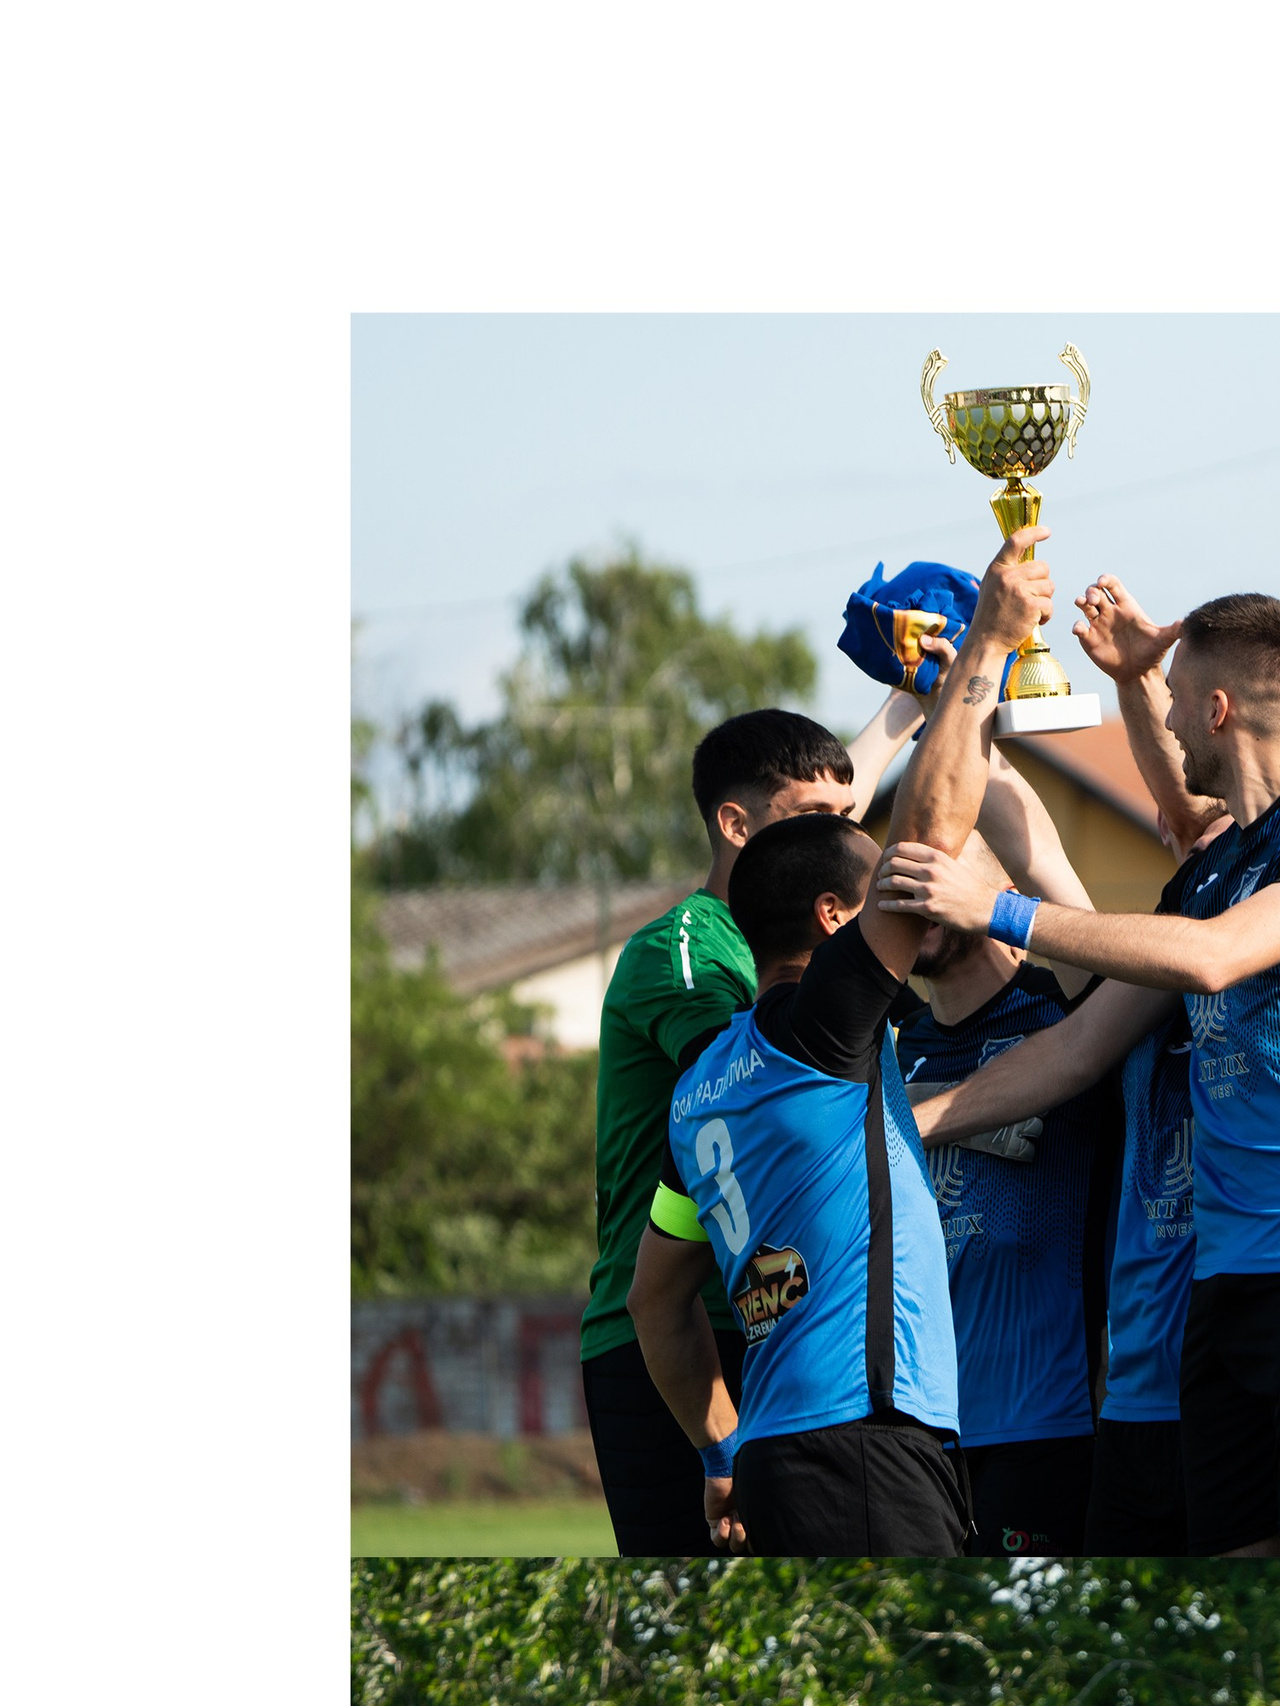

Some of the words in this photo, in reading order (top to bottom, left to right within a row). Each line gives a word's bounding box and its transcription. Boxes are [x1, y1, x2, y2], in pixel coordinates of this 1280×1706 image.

[695, 1118, 751, 1256] 3
[1144, 1198, 1178, 1219] MT
[942, 1213, 984, 1240] LUX
